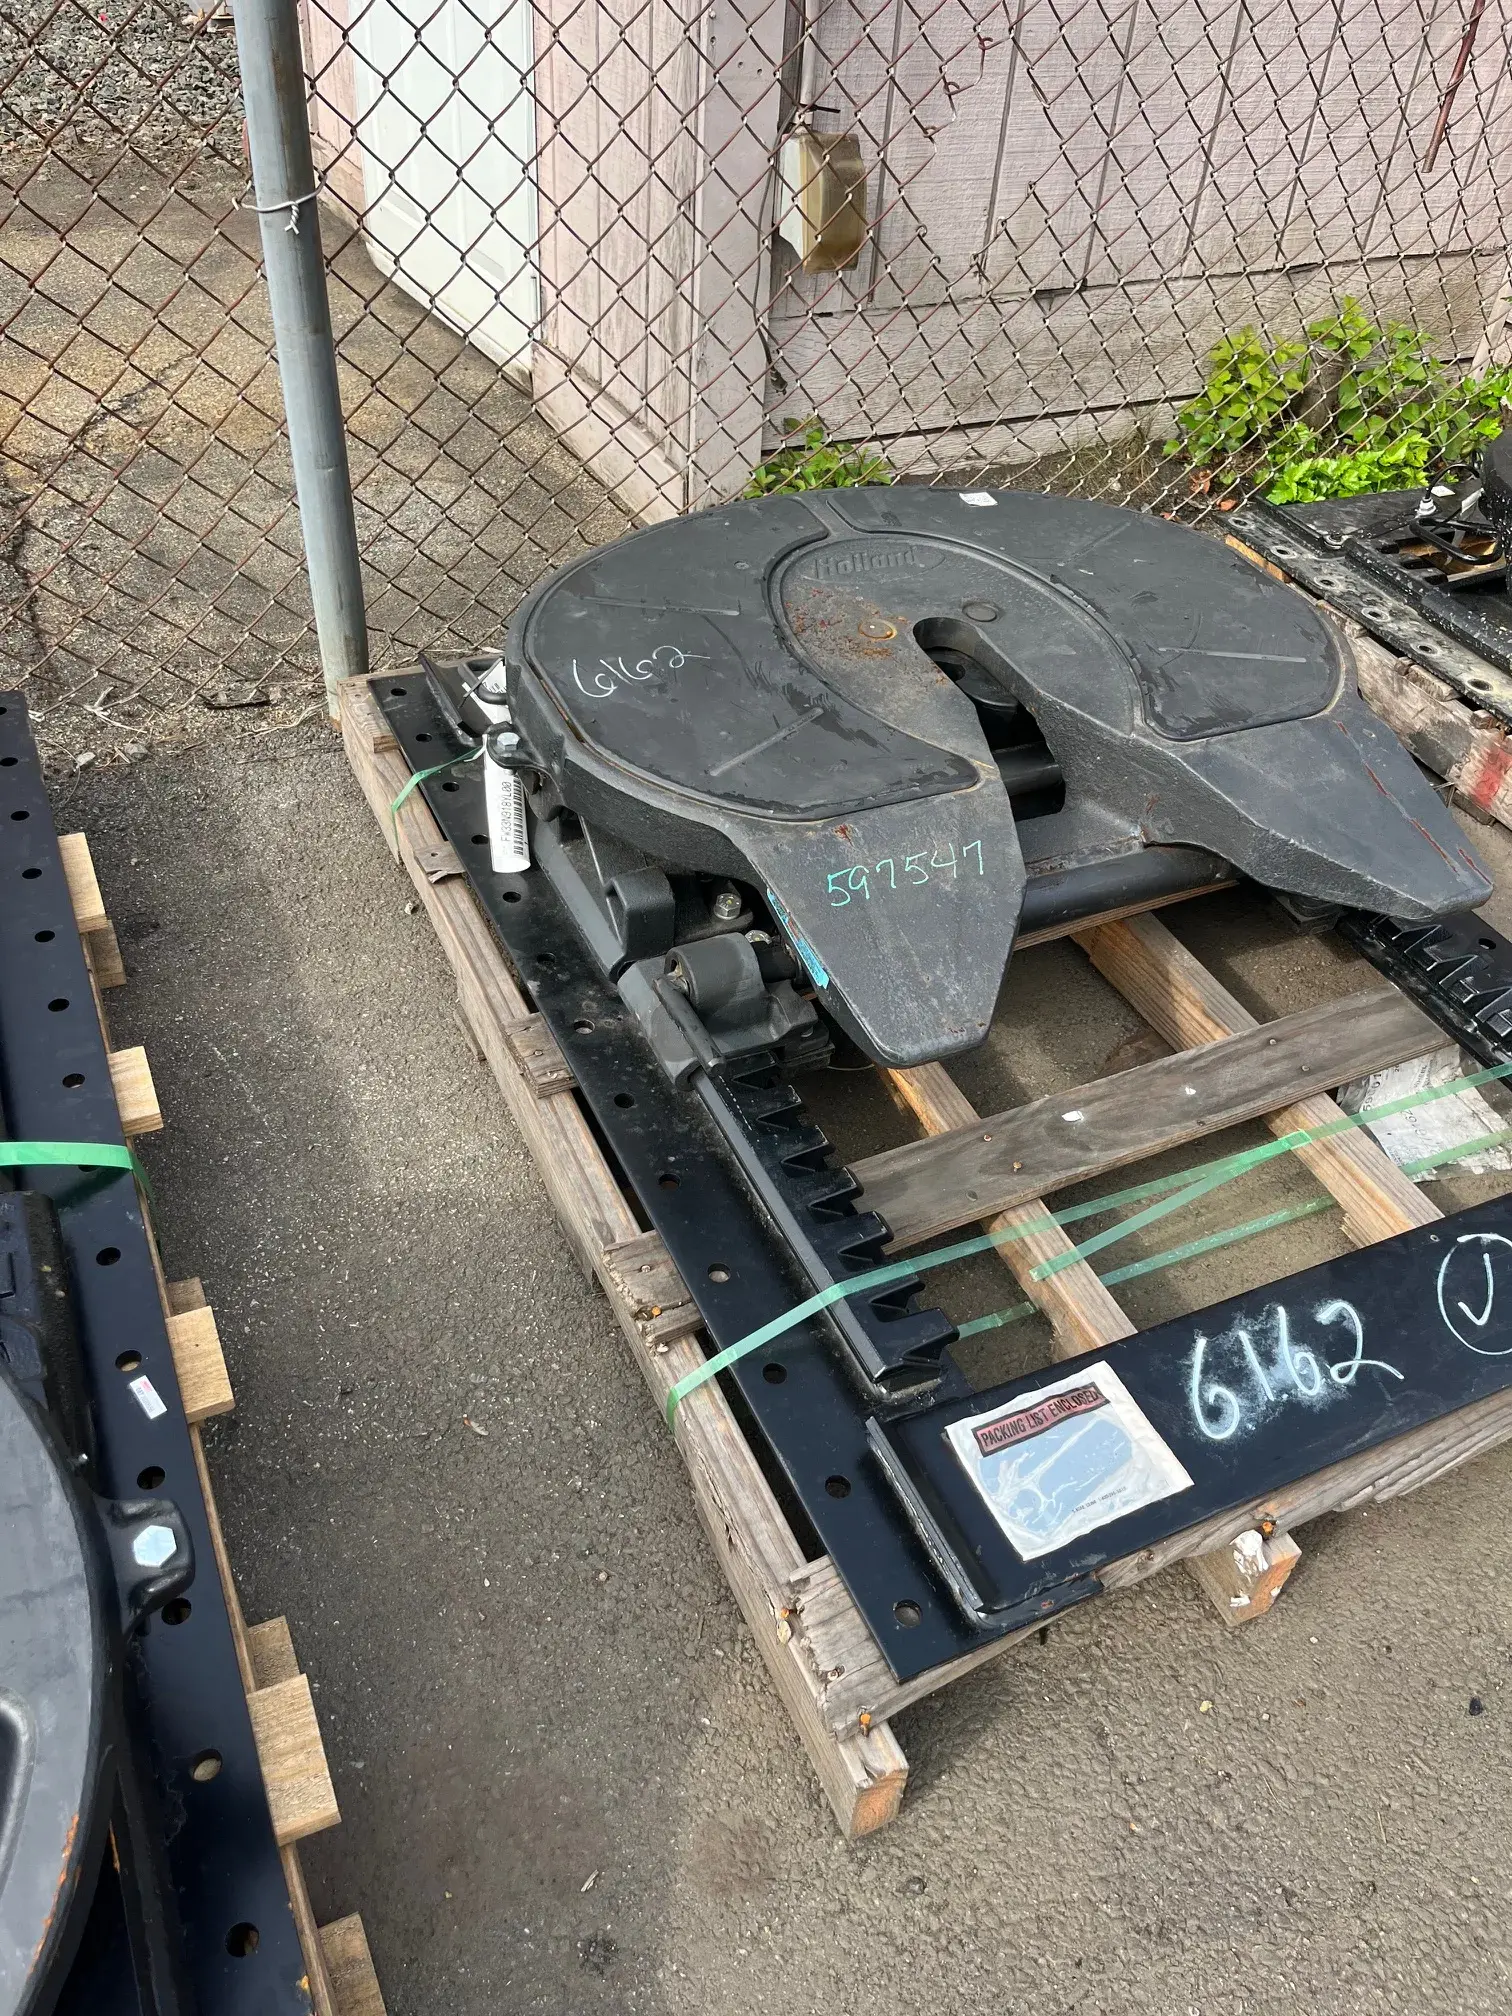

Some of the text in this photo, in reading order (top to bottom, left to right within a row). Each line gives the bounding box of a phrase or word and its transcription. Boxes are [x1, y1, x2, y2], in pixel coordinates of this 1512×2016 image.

[814, 545, 917, 579] Holland
[572, 645, 710, 698] 6162
[827, 839, 984, 907] 597547
[1192, 1301, 1405, 1440] 6162
[980, 1389, 1100, 1447] PACKING LIST ENCLOSED
